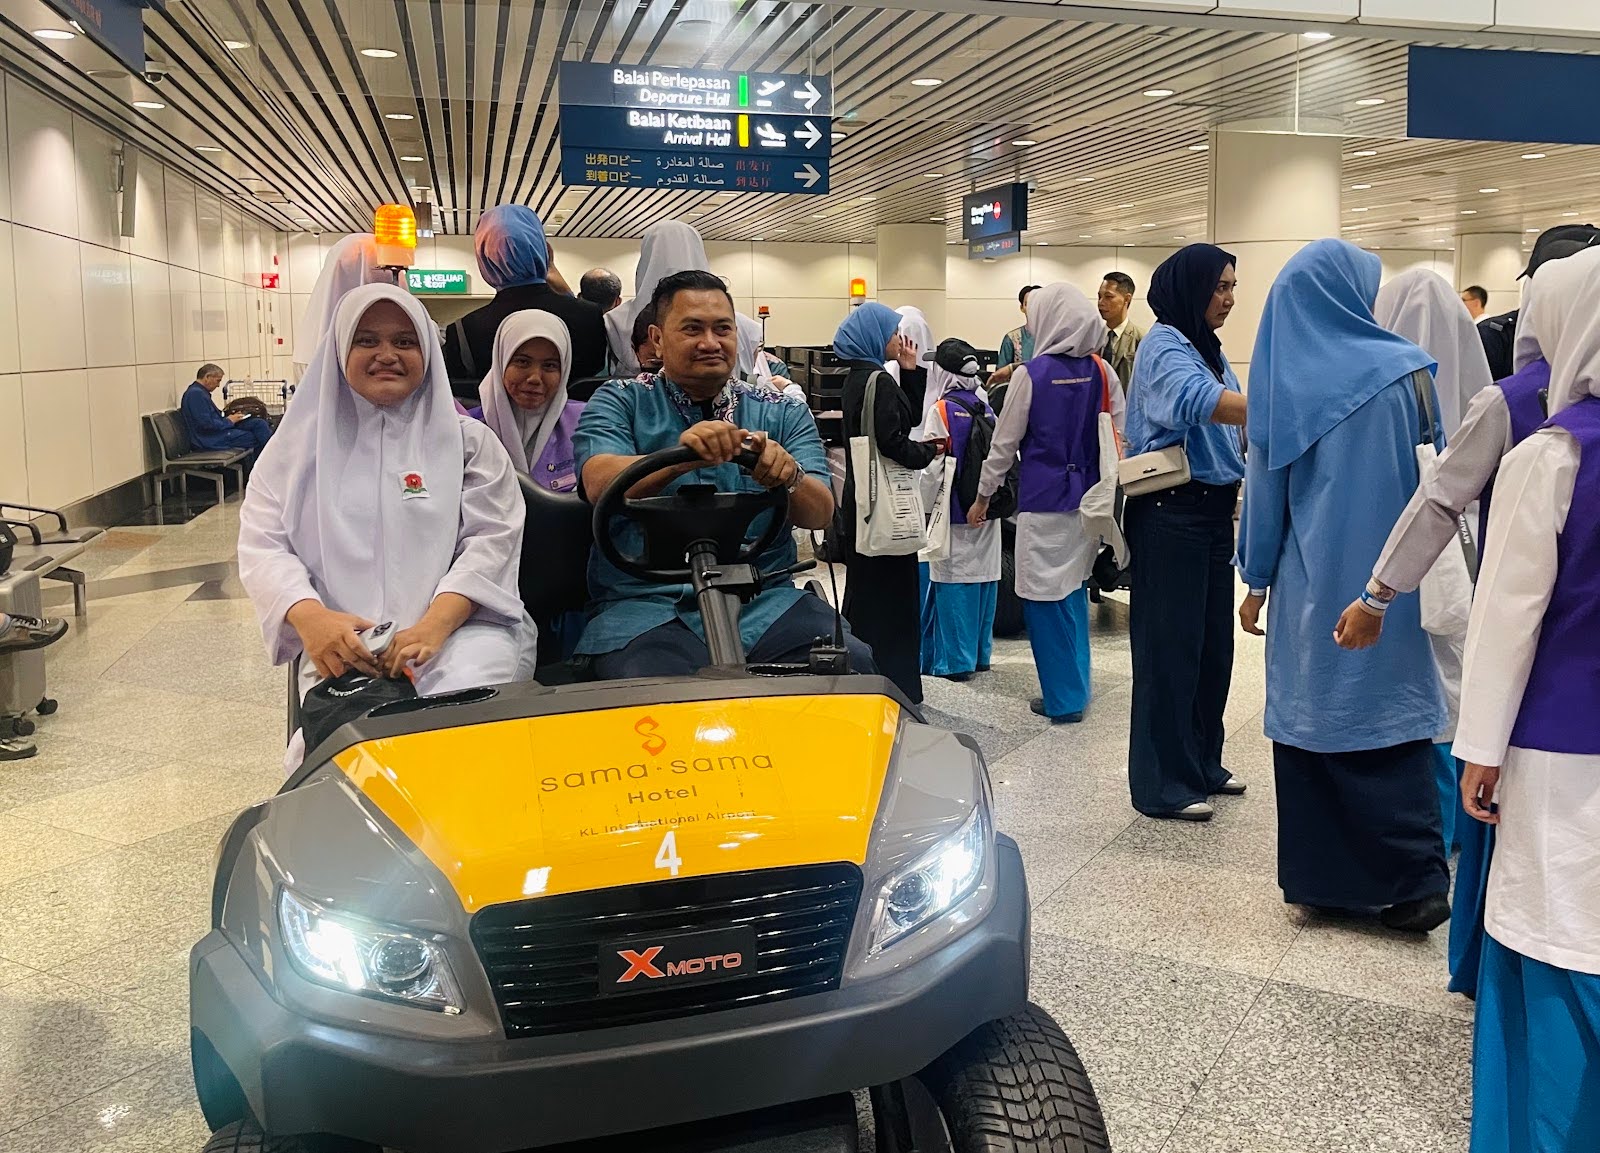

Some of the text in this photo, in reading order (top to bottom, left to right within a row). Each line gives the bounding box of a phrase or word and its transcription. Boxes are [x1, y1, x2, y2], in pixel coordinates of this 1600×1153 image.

[613, 69, 731, 91] Balai Perlepasan
[639, 89, 730, 106] Departure Hall
[629, 110, 731, 131] Balai Ketibaan
[663, 130, 731, 147] Arrival Hall
[585, 153, 642, 166] 出発ロビー
[656, 156, 724, 170] صالة المغادرة
[585, 169, 643, 183] 到着ロビー
[656, 173, 724, 186] صالة القدوم
[432, 274, 463, 282] KELUAR
[627, 785, 698, 805] Hotel
[579, 828, 599, 838] KL
[654, 830, 683, 876] 4
[616, 945, 742, 983] X MOTO
